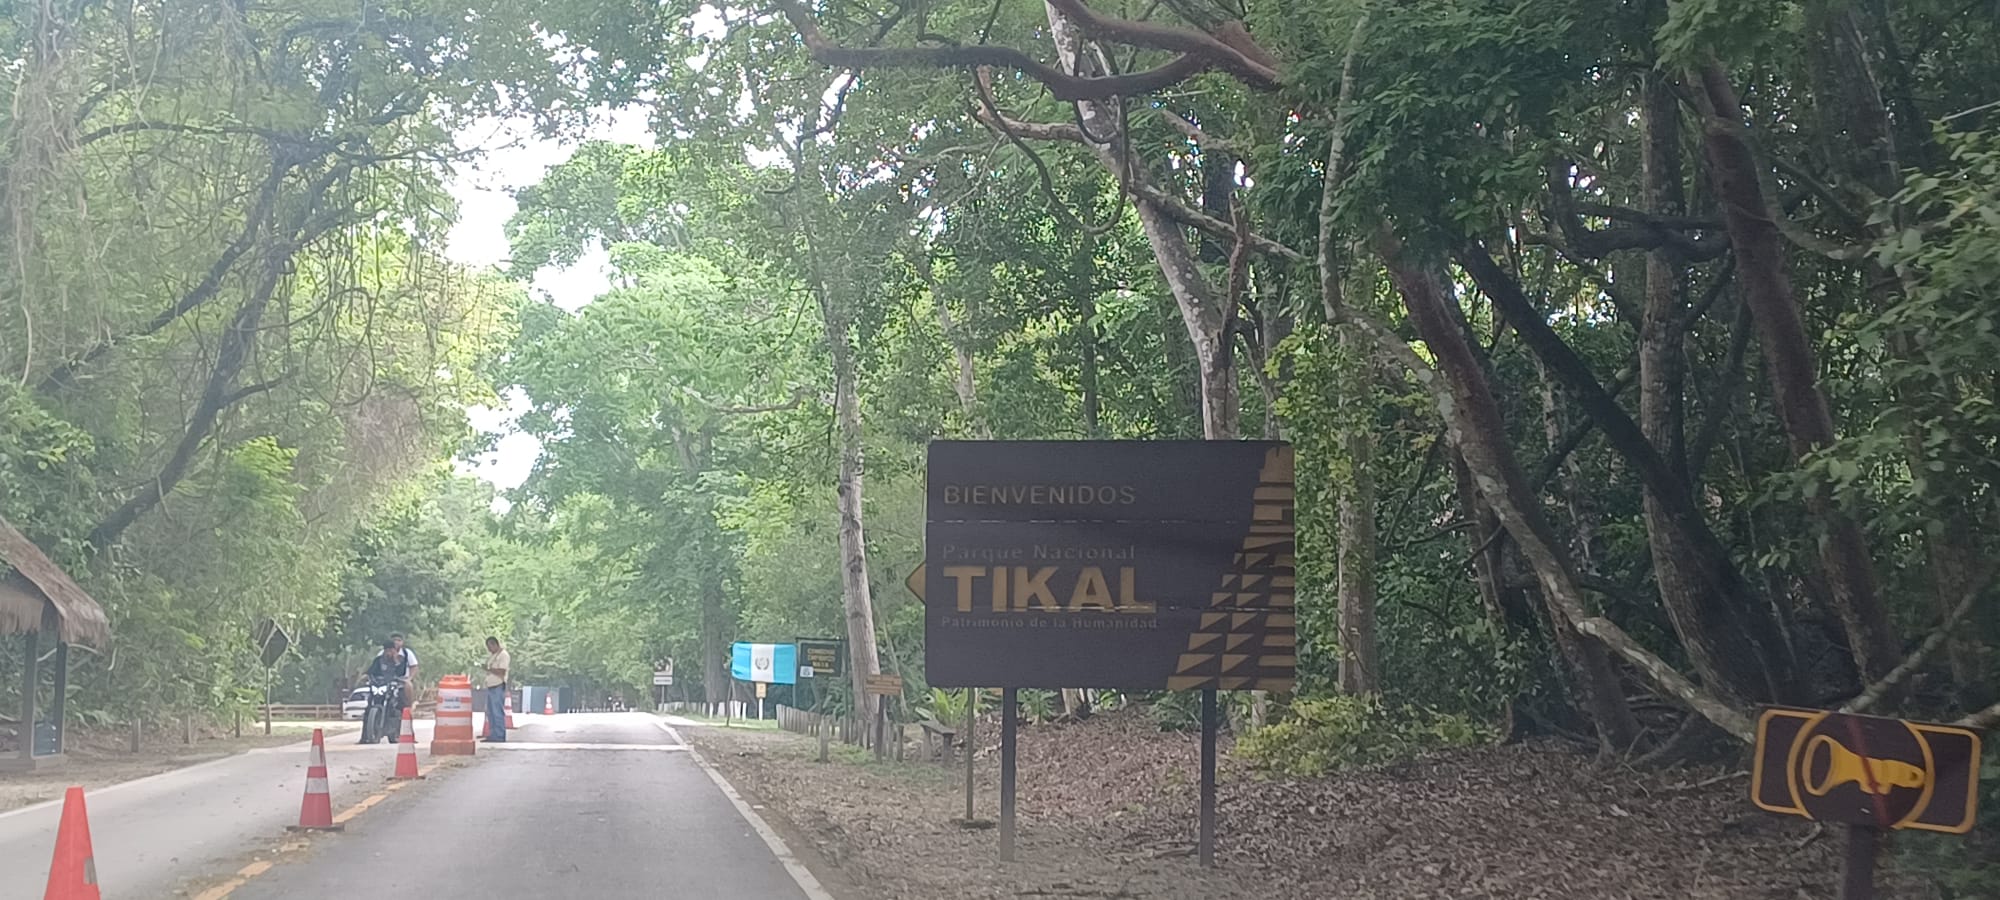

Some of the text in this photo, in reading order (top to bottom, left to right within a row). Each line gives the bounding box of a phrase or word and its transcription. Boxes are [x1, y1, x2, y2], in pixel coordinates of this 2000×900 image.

[944, 485, 1136, 505] BIENVENIDOS
[942, 544, 1135, 563] Parque Nacional
[943, 565, 1157, 613] TIKAL
[941, 615, 1158, 630] Patrimonio de la Humanidad
